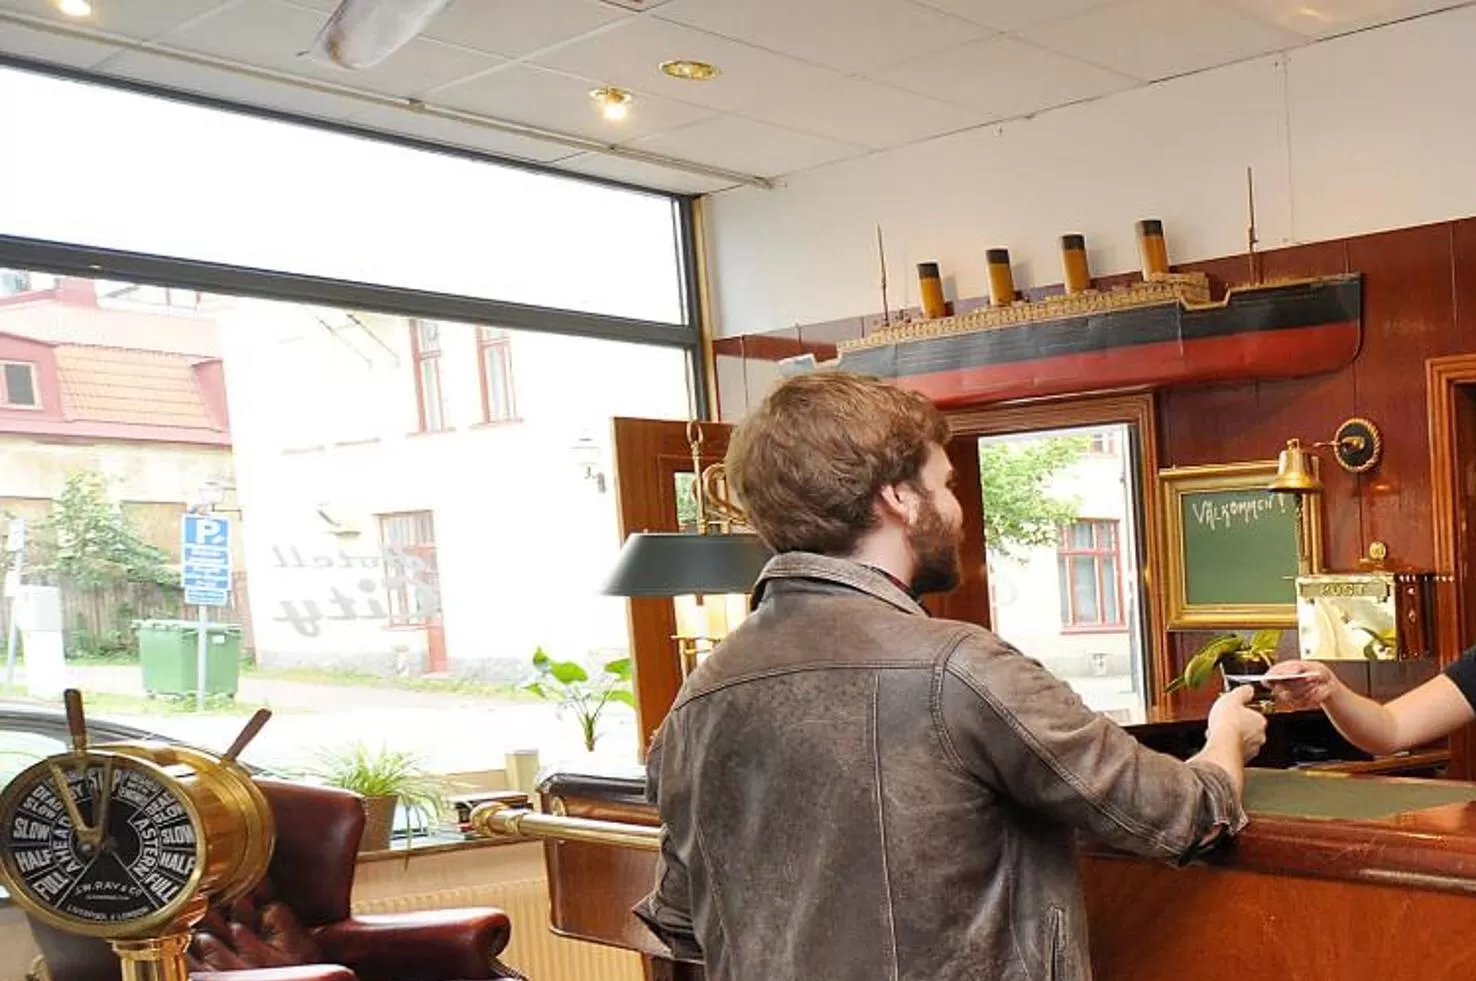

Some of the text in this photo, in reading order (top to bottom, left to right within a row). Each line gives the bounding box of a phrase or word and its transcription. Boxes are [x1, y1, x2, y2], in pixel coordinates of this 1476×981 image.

[22, 797, 57, 819] SLOW
[13, 818, 50, 840] SLOW
[161, 824, 197, 845] SLOW
[53, 814, 81, 873] AHEAD
[132, 818, 158, 877] ASTERN
[15, 849, 52, 873] HALF
[160, 851, 195, 875] HALF
[32, 871, 69, 901] FULL
[144, 873, 179, 903] FULL
